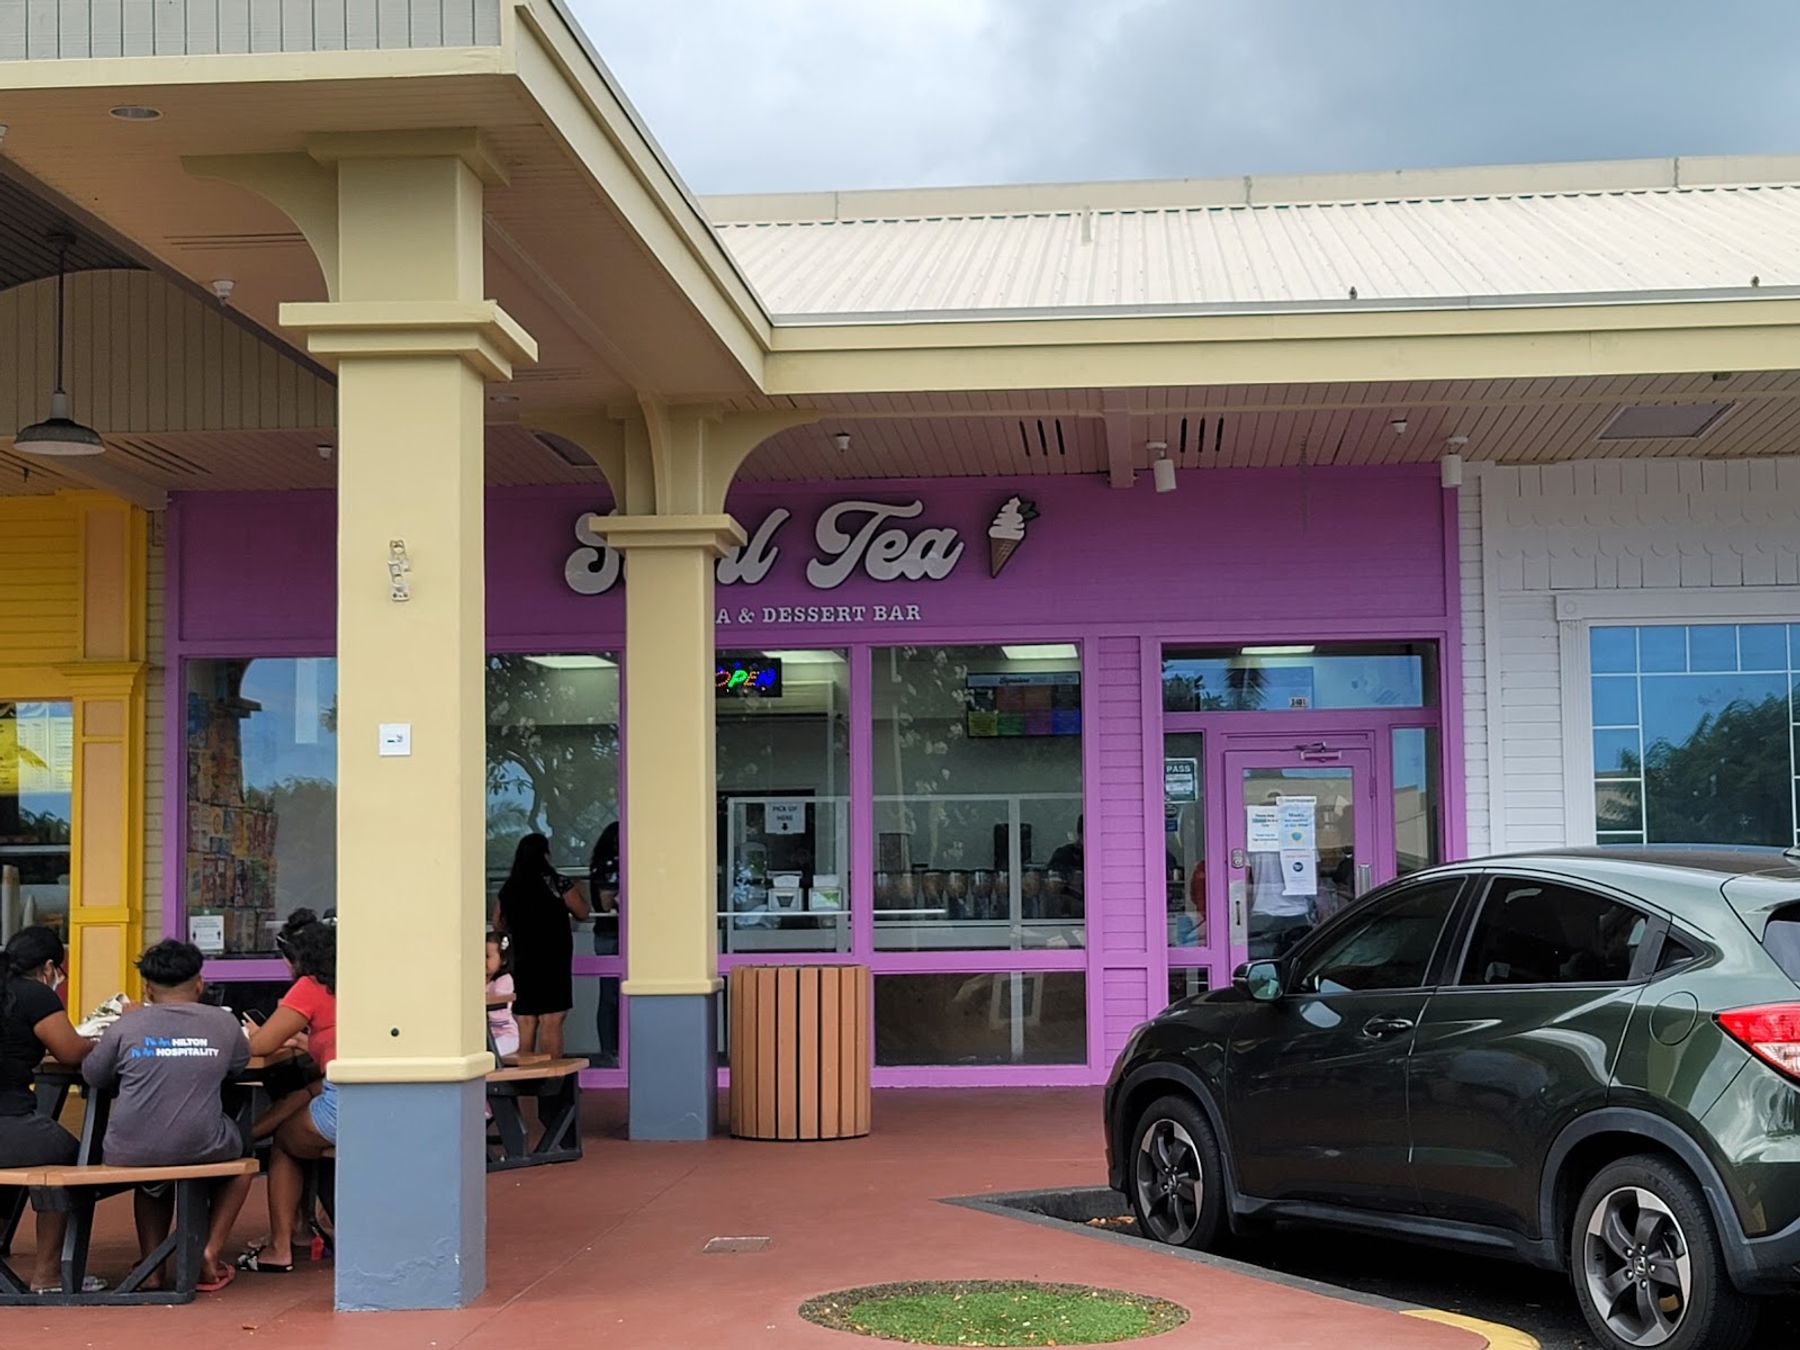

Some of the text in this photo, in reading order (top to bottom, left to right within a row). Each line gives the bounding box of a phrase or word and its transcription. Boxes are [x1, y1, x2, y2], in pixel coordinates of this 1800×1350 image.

[806, 500, 965, 589] Tea
[738, 607, 755, 624] &
[762, 606, 866, 624] DESSERT
[873, 604, 921, 621] BAR
[715, 668, 776, 688] OPEN
[1166, 765, 1191, 773] PASS
[171, 1038, 208, 1047] HILTON
[155, 1047, 220, 1057] HOSPITALITY
